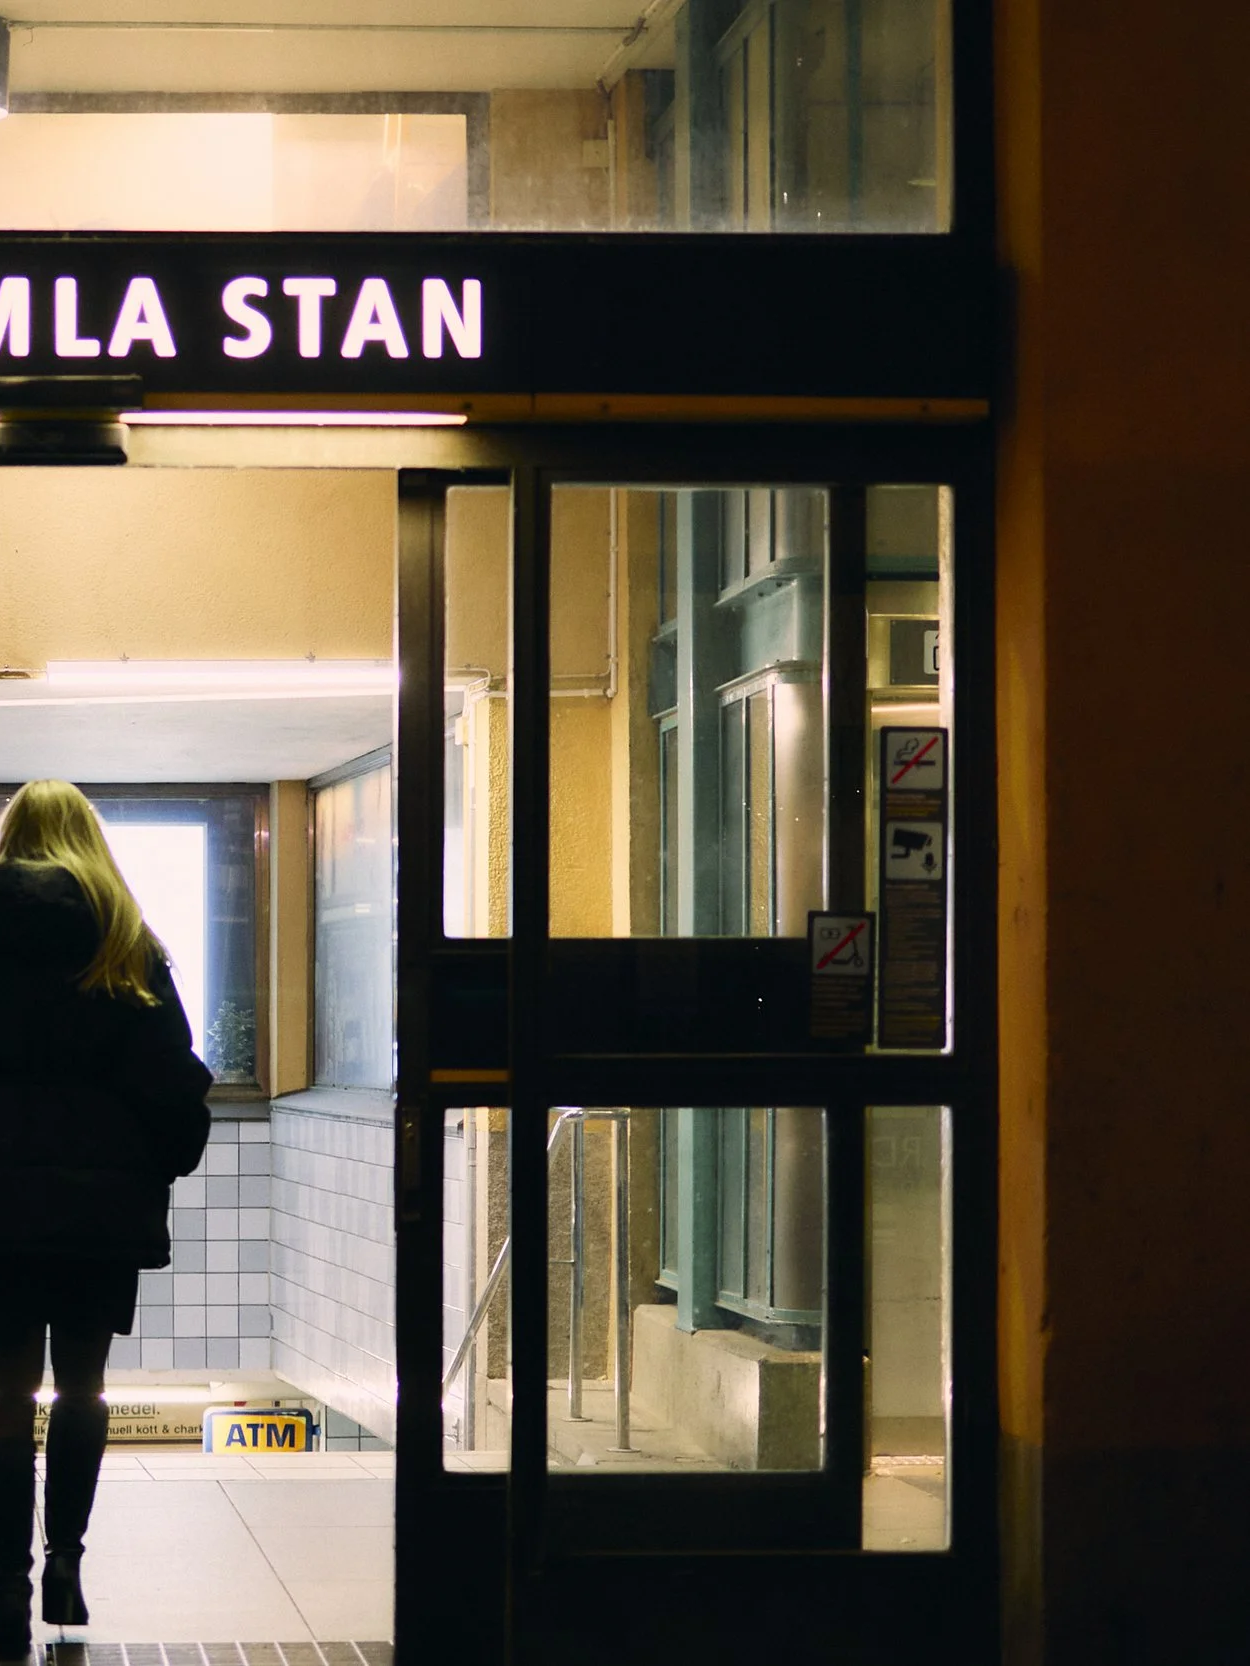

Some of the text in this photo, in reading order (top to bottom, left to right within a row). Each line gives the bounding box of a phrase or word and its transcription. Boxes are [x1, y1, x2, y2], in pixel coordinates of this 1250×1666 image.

[222, 275, 483, 360] STAN
[106, 1424, 132, 1435] nuell
[161, 1424, 170, 1434] &
[225, 1423, 296, 1448] ATM
